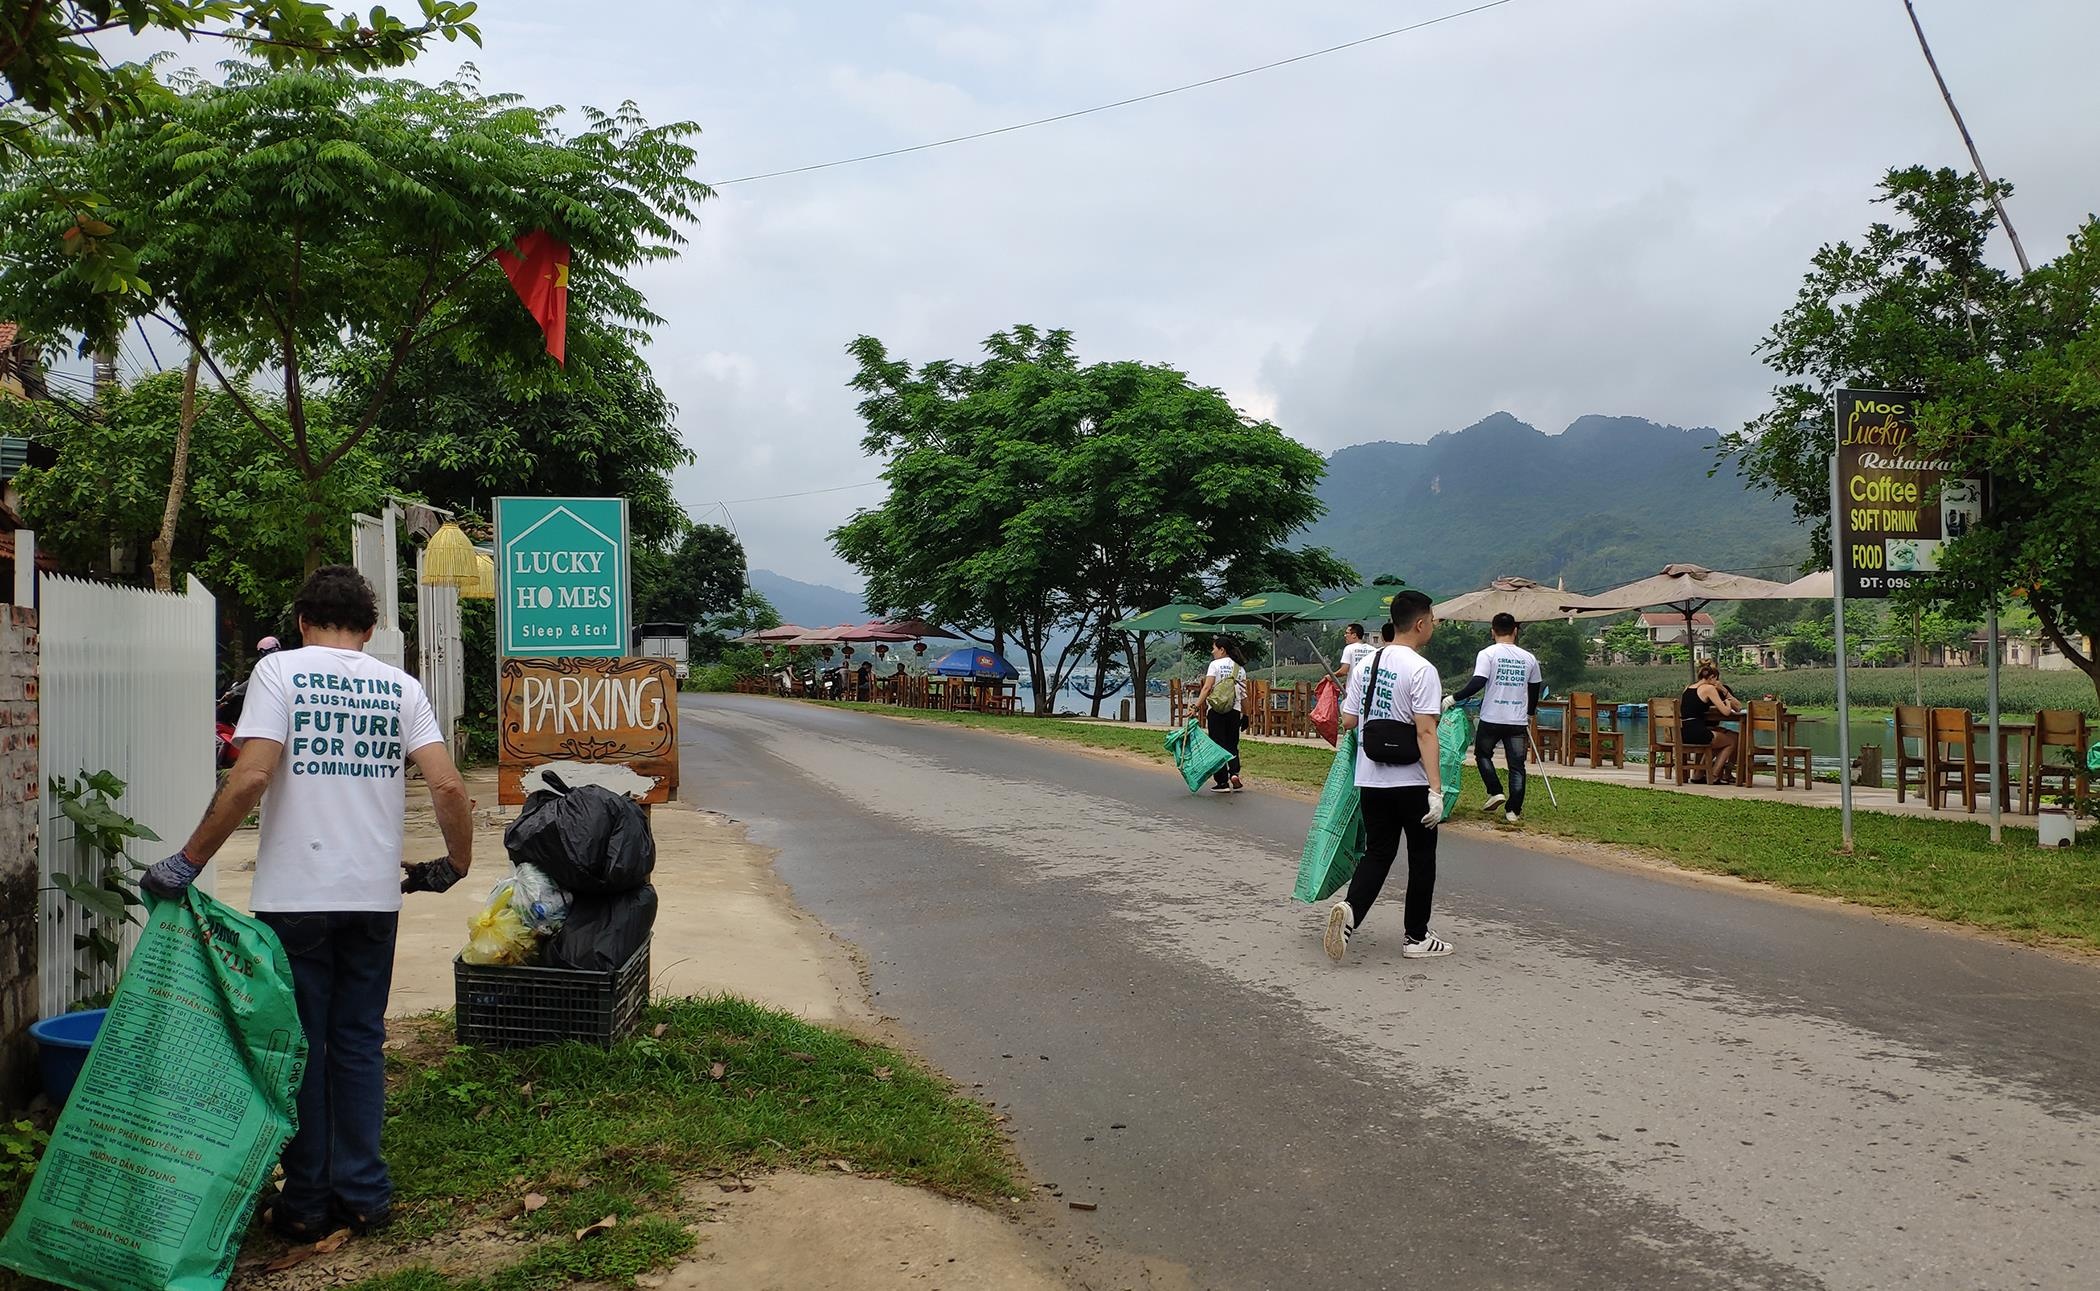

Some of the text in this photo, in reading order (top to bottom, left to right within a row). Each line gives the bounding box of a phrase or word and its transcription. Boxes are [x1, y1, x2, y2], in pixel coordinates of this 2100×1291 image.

[1855, 400, 1905, 414] Moc
[1841, 412, 1907, 457] Lucky
[1849, 475, 1918, 504] Coffee
[1850, 508, 1918, 532] SOFT DRINK
[515, 551, 605, 574] LUCKY
[1852, 544, 1883, 570] FOOD
[516, 586, 612, 609] HOMES
[522, 624, 608, 639] Sleep & Eat
[293, 672, 402, 698] CREATING
[295, 694, 305, 705] A
[523, 673, 663, 735] PARKING
[294, 711, 400, 737] FUTURE
[293, 737, 402, 760] FOR OUR
[292, 761, 400, 778] COMMUNITY
